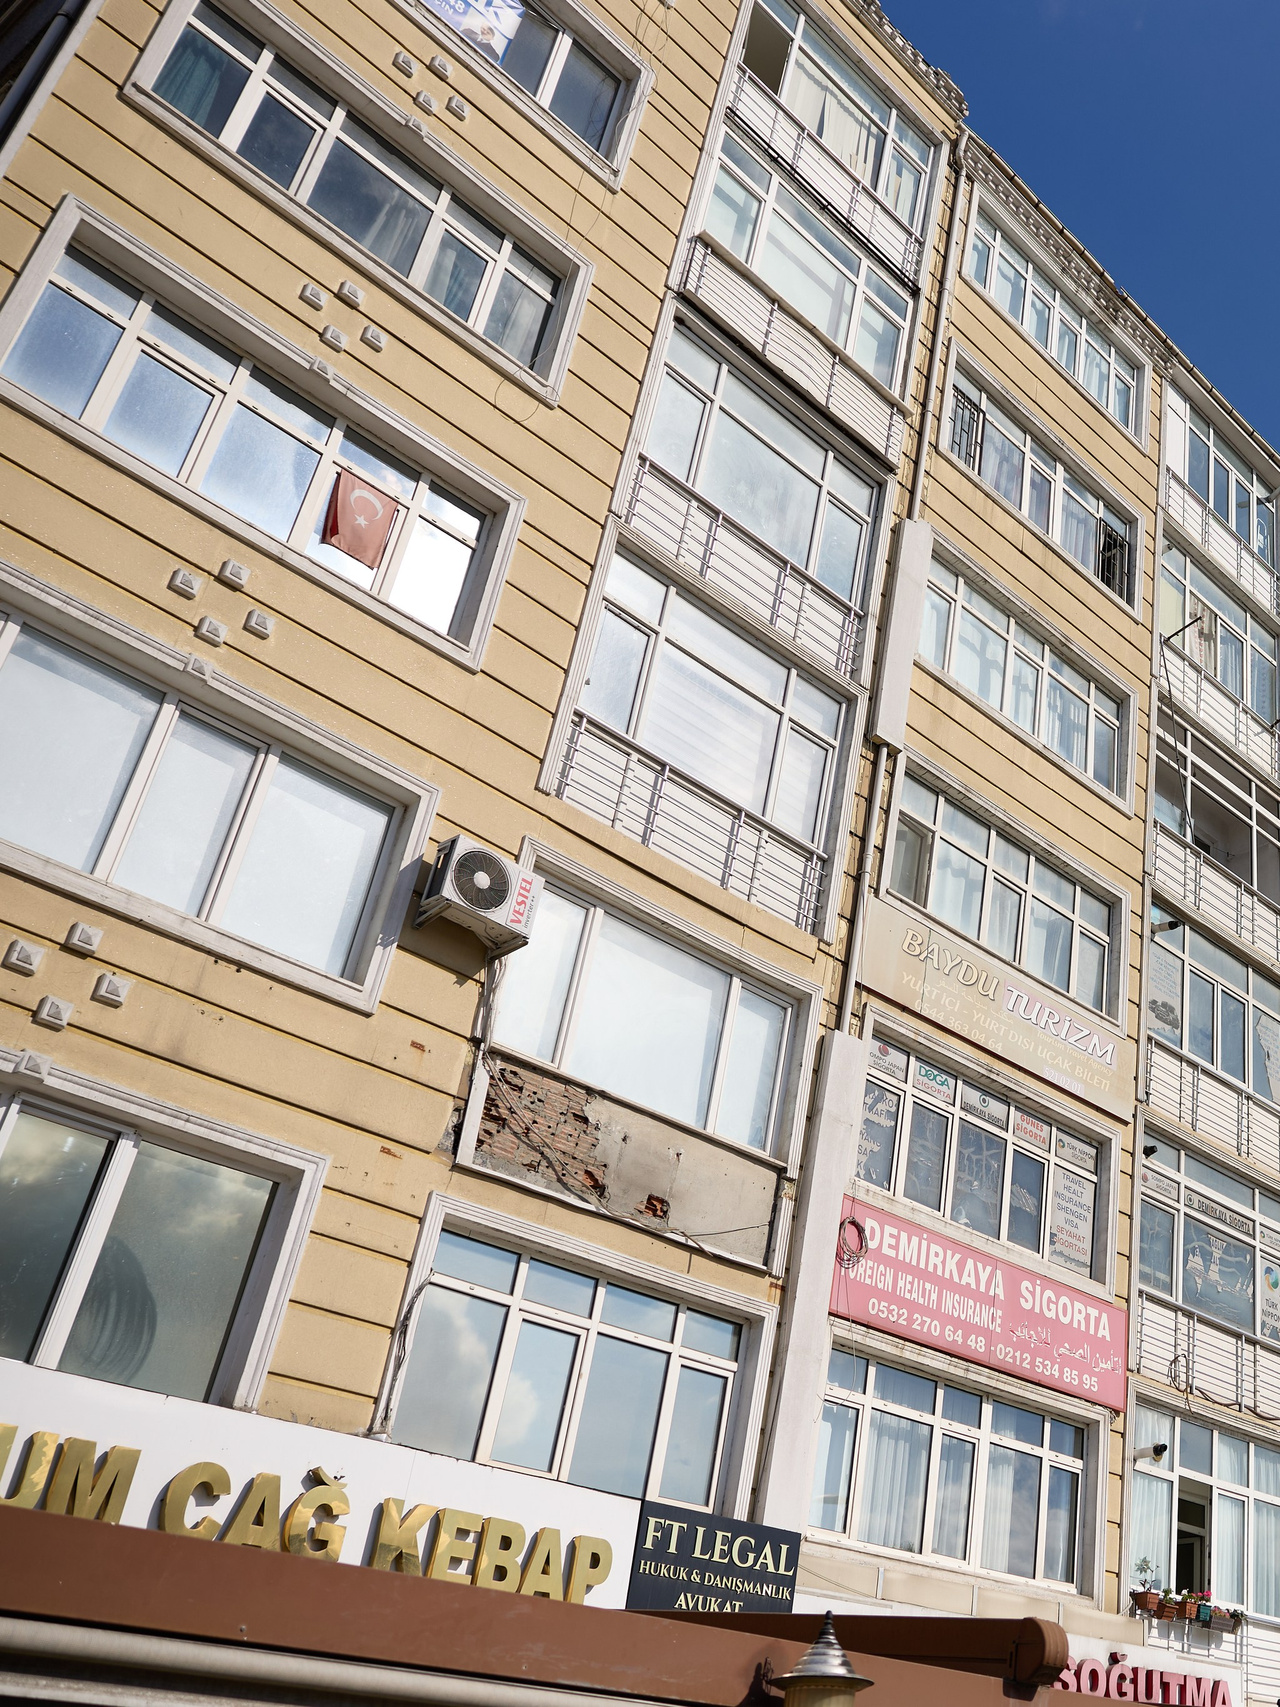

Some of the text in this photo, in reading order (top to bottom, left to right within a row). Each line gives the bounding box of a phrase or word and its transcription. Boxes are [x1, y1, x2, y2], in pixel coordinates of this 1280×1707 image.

[510, 877, 534, 926] VESTEL
[901, 928, 1116, 1066] BAYDU TURİZM
[902, 971, 940, 1000] YURT
[972, 1009, 1009, 1037] YURT
[1037, 1047, 1072, 1073] UÇAK
[913, 999, 1003, 1052] 0544 363 04 64
[869, 1052, 887, 1066] OMPO
[1037, 1030, 1113, 1077] Tourism Travel Agency
[1044, 1067, 1060, 1084] 521
[1060, 1075, 1071, 1090] 02
[1015, 1121, 1047, 1146] SİGORTA
[1054, 1190, 1092, 1214] INSURANCE
[1062, 1172, 1086, 1191] TRAVEL
[1063, 1183, 1084, 1199] HEALT
[1056, 1202, 1088, 1223] SHENGEN
[1064, 1216, 1079, 1231] VISA
[1197, 1198, 1252, 1234] DEMİRKAYA SİGORTA
[1056, 1225, 1086, 1245] SEYAHAT
[864, 1217, 1111, 1342] DEMİRKAYA SİGORTA
[896, 1271, 939, 1311] HEALTH
[941, 1290, 1003, 1334] INSURANCE
[1265, 1298, 1279, 1312] TÜRK
[868, 1298, 908, 1326] 0532
[912, 1313, 941, 1337] 270
[944, 1326, 963, 1345] 64
[967, 1334, 986, 1353] 48
[996, 1344, 1031, 1370] 0212
[1035, 1357, 1060, 1380] 534
[1063, 1367, 1079, 1386] 85
[1082, 1374, 1099, 1392] 95
[368, 1497, 613, 1603] KEBAP
[642, 1516, 796, 1577] FT LEGAL
[638, 1559, 792, 1602] HUKUK & DANIŞMANLIK
[1053, 1651, 1233, 1707] SOĞUTMA
